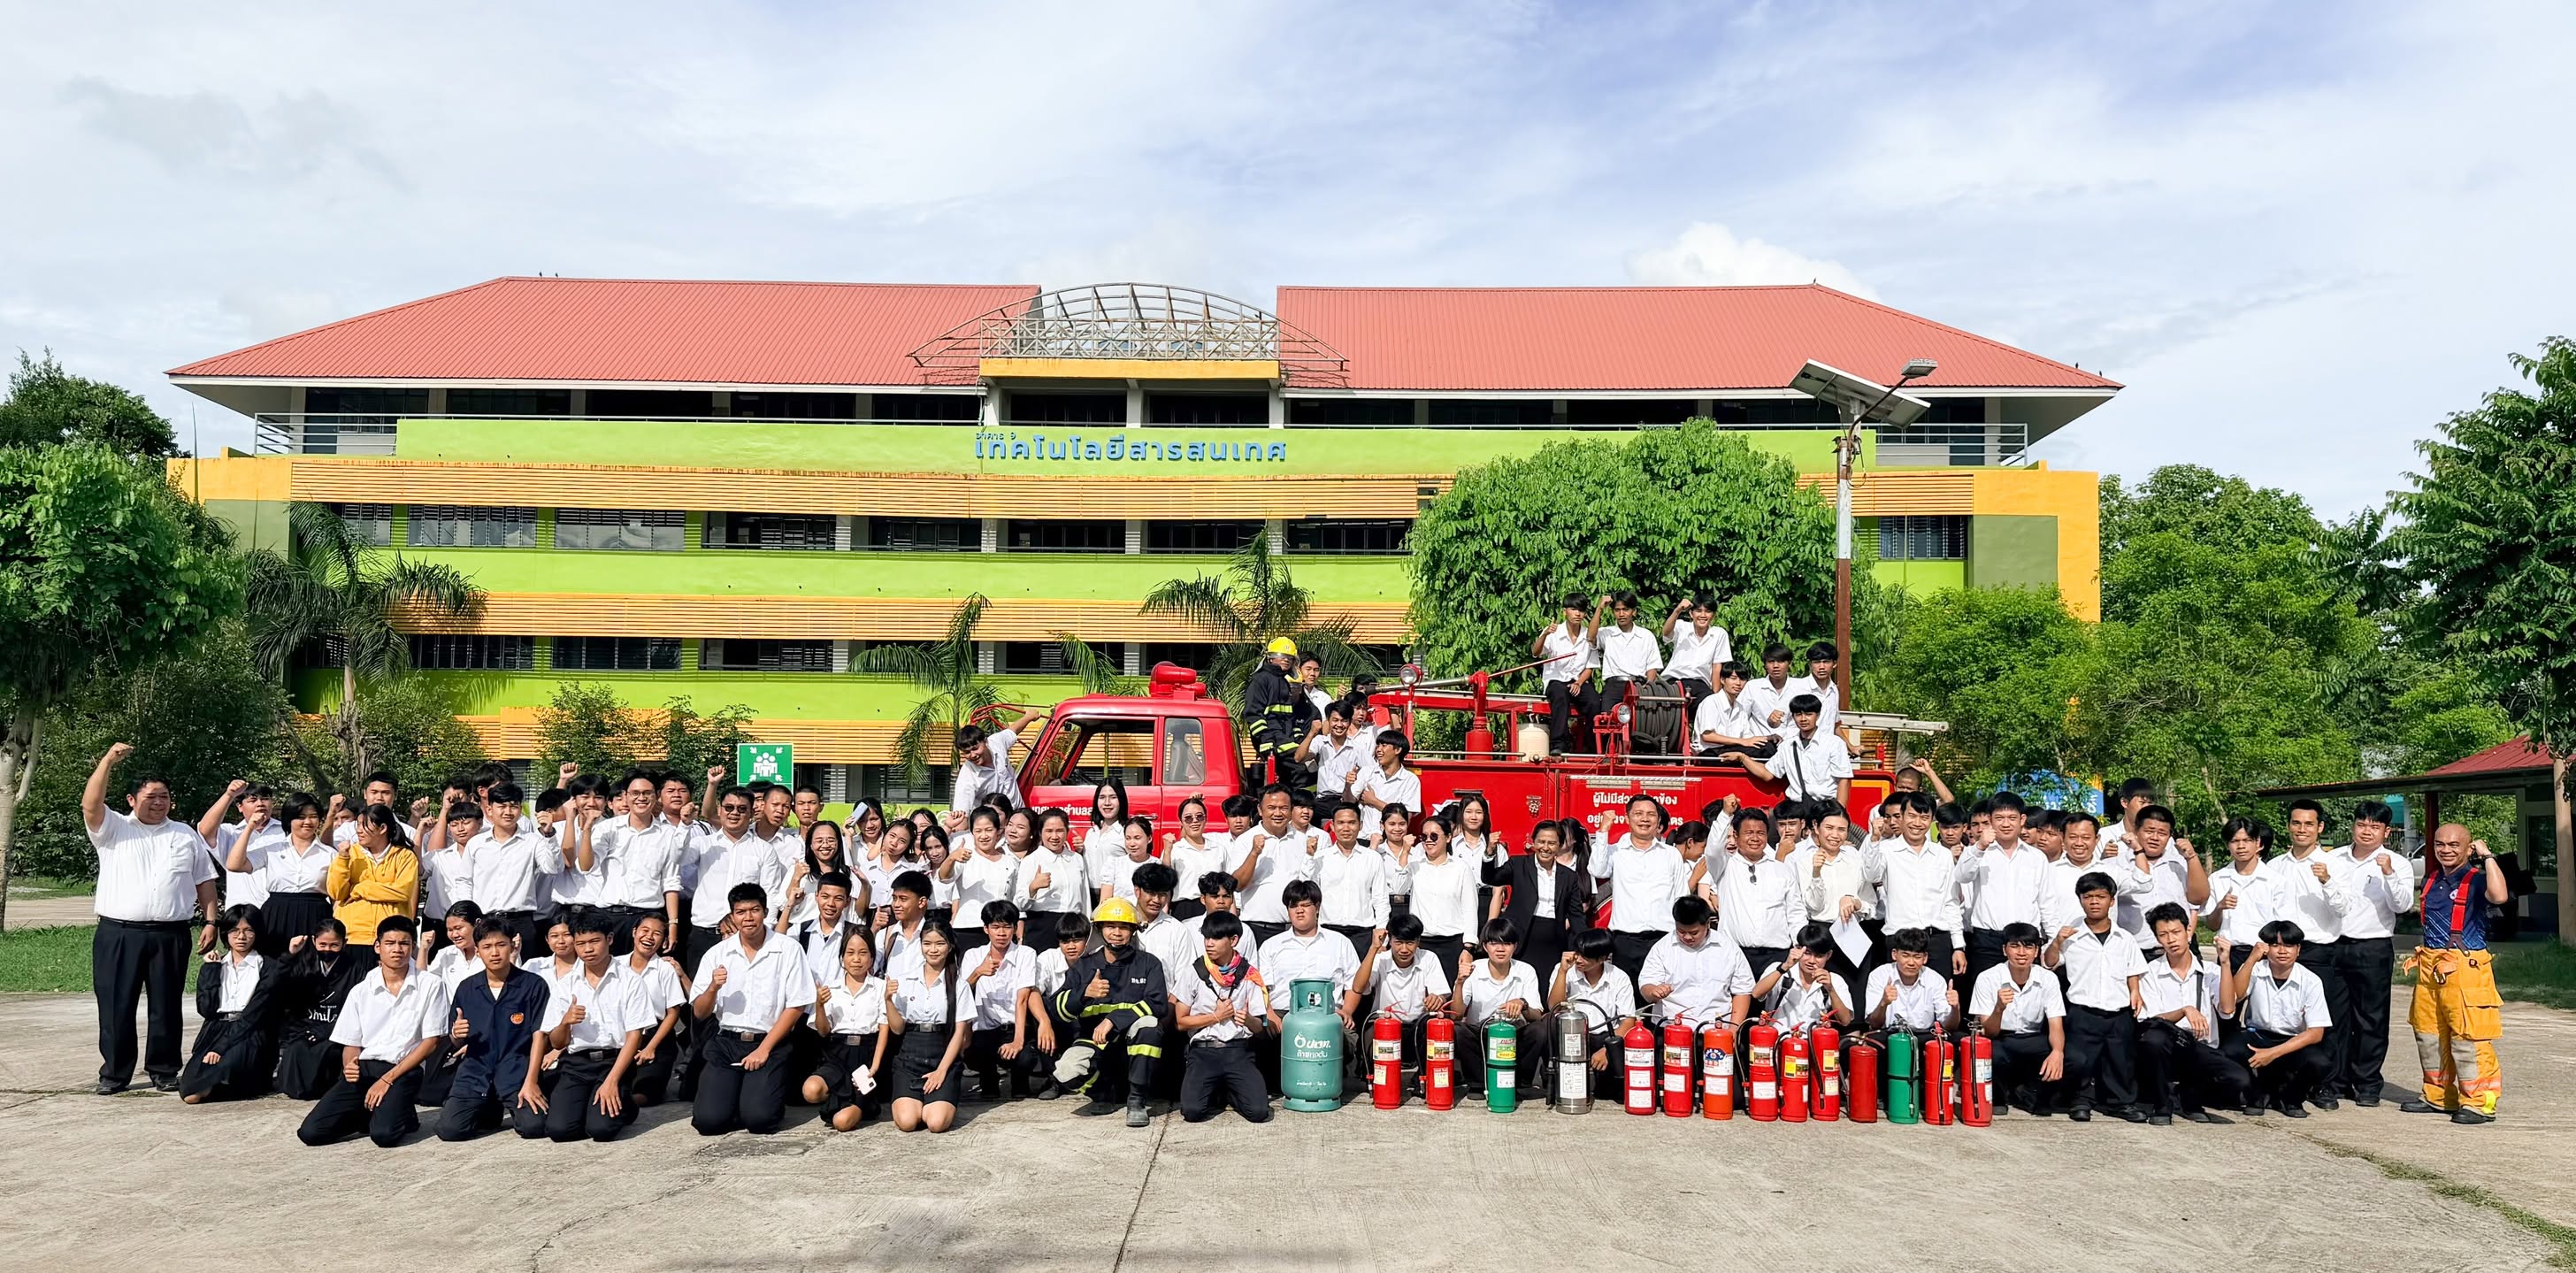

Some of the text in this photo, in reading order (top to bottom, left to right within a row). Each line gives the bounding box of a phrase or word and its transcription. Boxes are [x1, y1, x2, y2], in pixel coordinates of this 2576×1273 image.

[975, 433, 1286, 462] เทคโนโลยีสารสนเทศ
